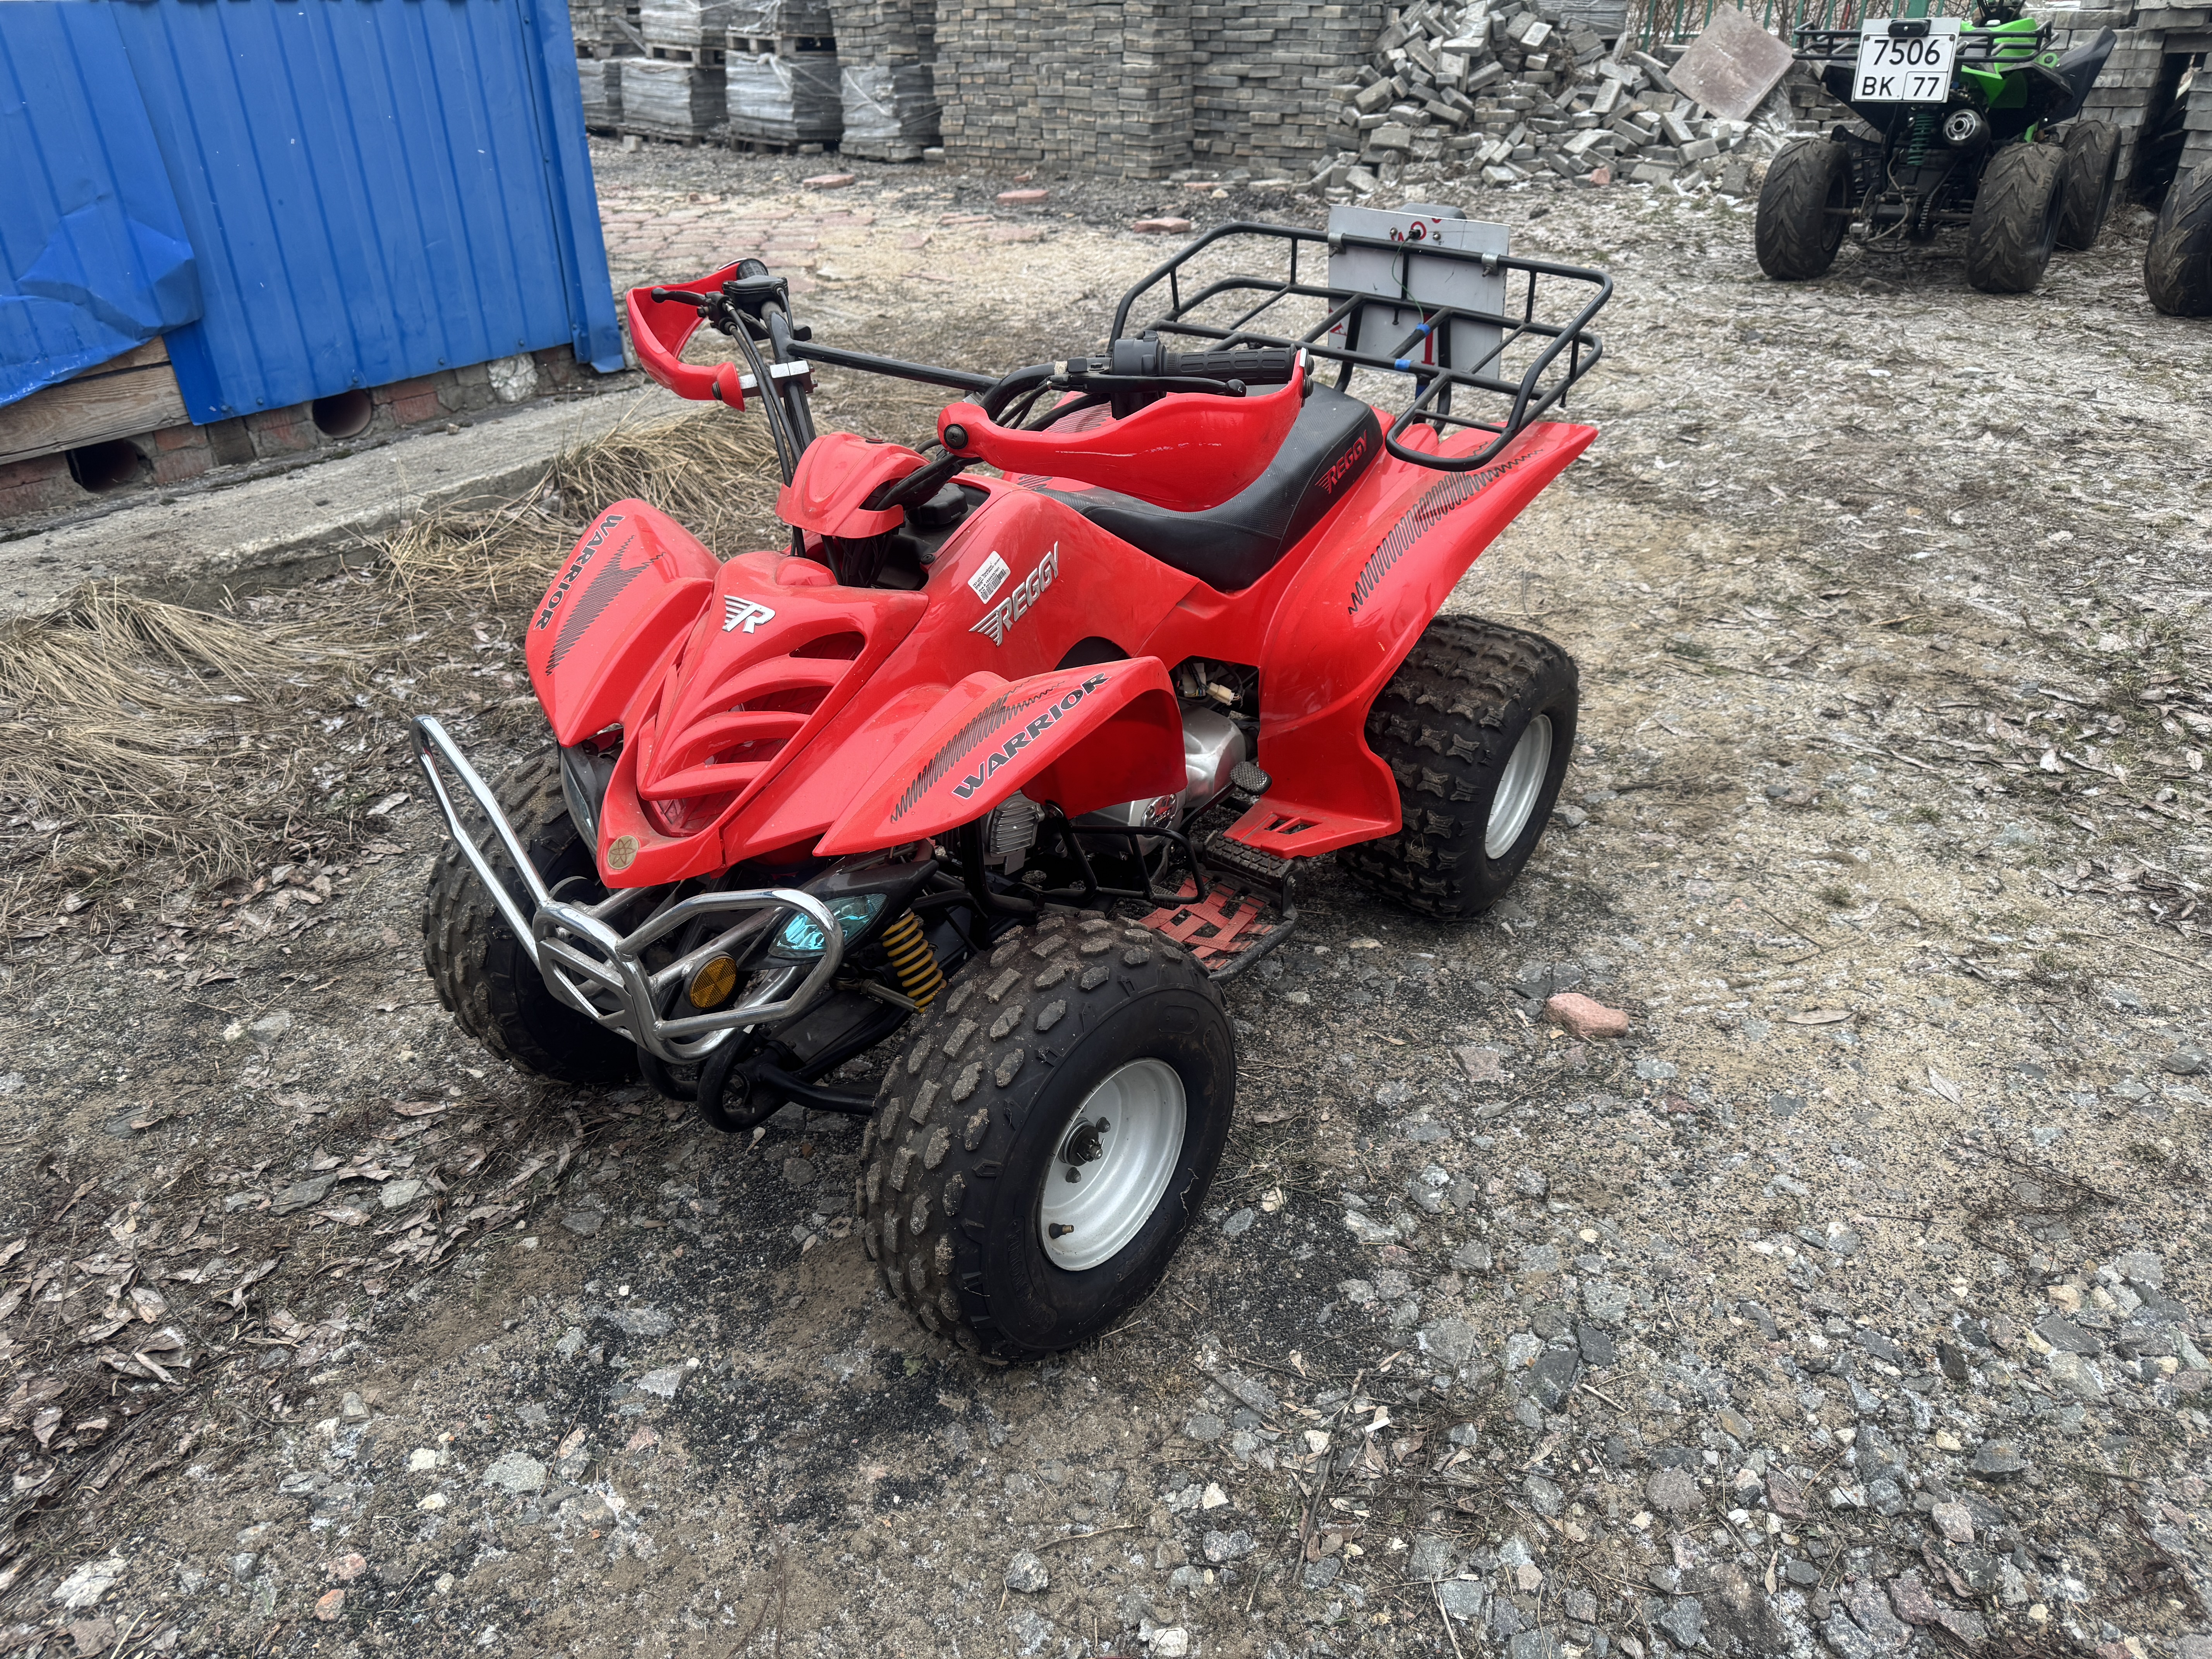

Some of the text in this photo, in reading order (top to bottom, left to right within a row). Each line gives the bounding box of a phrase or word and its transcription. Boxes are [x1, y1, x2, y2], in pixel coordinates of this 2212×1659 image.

[1862, 76, 1939, 96] ВК 77
[1874, 39, 1941, 65] 7506
[1315, 429, 1367, 494] REGGY
[533, 514, 625, 630] WARRIOR
[969, 541, 1058, 647] REGGY
[951, 672, 1112, 799] WARRIOR
